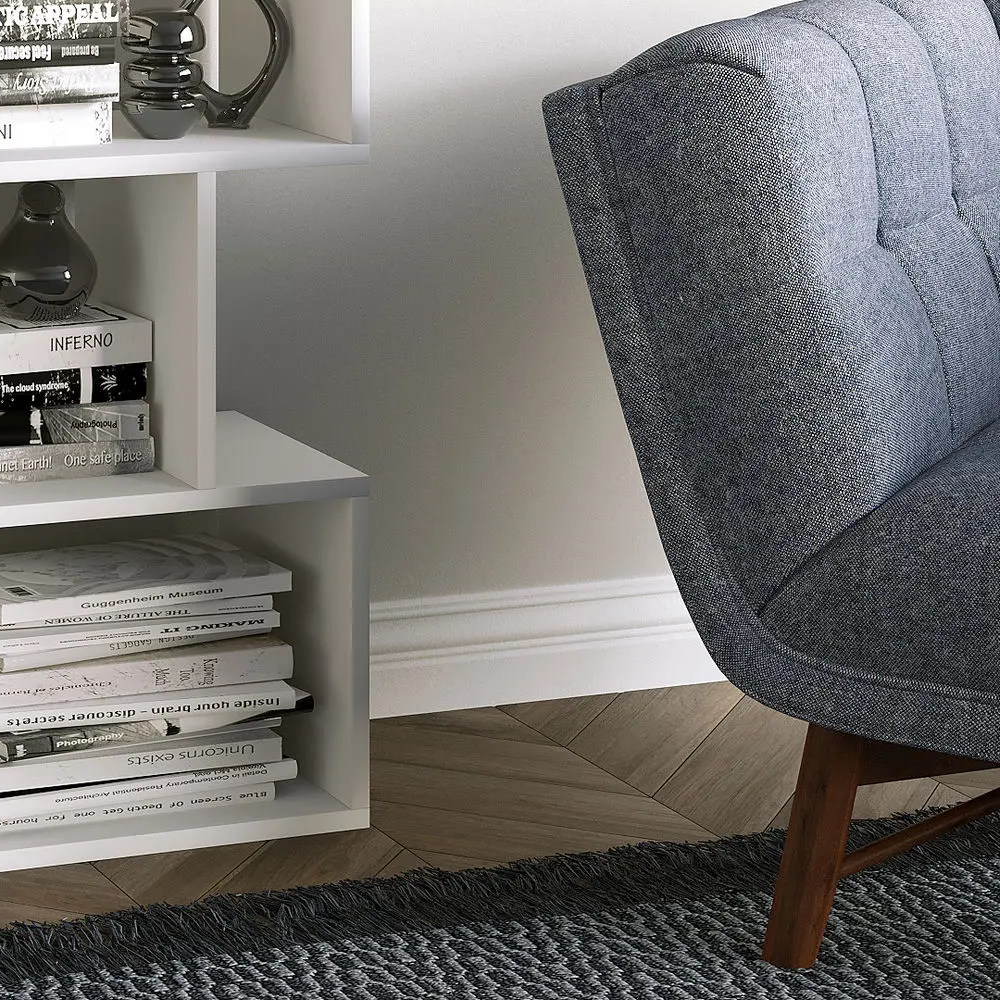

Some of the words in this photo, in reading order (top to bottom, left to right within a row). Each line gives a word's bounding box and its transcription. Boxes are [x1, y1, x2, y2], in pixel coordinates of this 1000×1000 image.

[31, 43, 50, 60] Feel
[13, 75, 47, 95] Story
[50, 332, 112, 350] INFERNO
[1, 384, 14, 393] The
[16, 383, 34, 392] cloud
[35, 382, 68, 393] syndrome
[70, 419, 116, 429] Photography
[64, 452, 87, 466] One
[89, 451, 112, 465] safe
[113, 448, 142, 464] place
[21, 456, 52, 471] Earth!
[80, 590, 164, 610] Guggenheim
[168, 586, 224, 598] Museum
[43, 615, 92, 624] WOMEN
[115, 610, 162, 619] ALLURE
[186, 618, 264, 631] MAKING
[109, 638, 152, 651] GADGETS
[193, 700, 229, 711] your
[233, 696, 279, 708] Inside
[68, 708, 136, 723] discover
[151, 704, 190, 715] brain
[6, 714, 64, 728] secrets
[55, 730, 125, 749] Photography
[178, 743, 254, 760] Unicorns
[126, 752, 175, 766] exists
[241, 768, 267, 778] Detail
[165, 774, 229, 789] Contemporary
[54, 790, 110, 804] Architecture
[190, 794, 232, 805] Screen
[238, 790, 266, 799] Blue
[126, 802, 162, 813] Death
[168, 800, 184, 808] Of
[73, 810, 95, 818] one
[102, 807, 123, 816] Get
[44, 814, 65, 822] for
